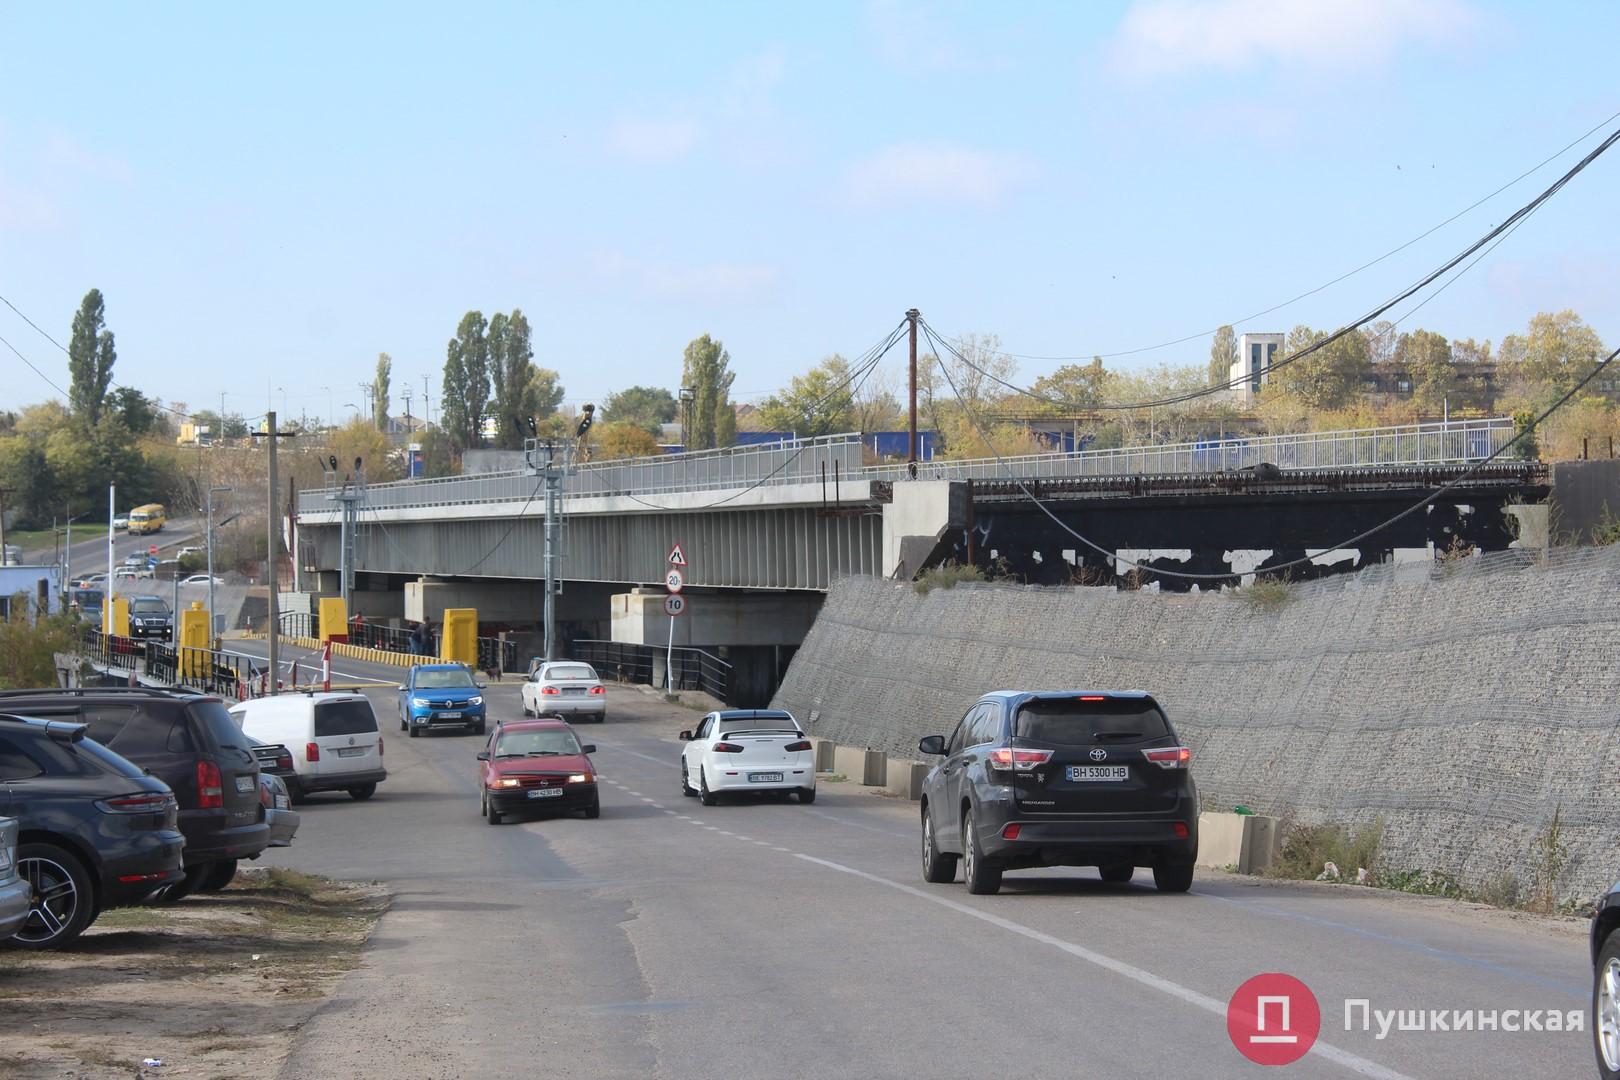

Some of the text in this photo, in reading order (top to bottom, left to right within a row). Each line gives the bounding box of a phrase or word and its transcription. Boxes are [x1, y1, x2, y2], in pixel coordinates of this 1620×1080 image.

[668, 599, 681, 610] 10
[1073, 767, 1127, 778] BH 5300 HB
